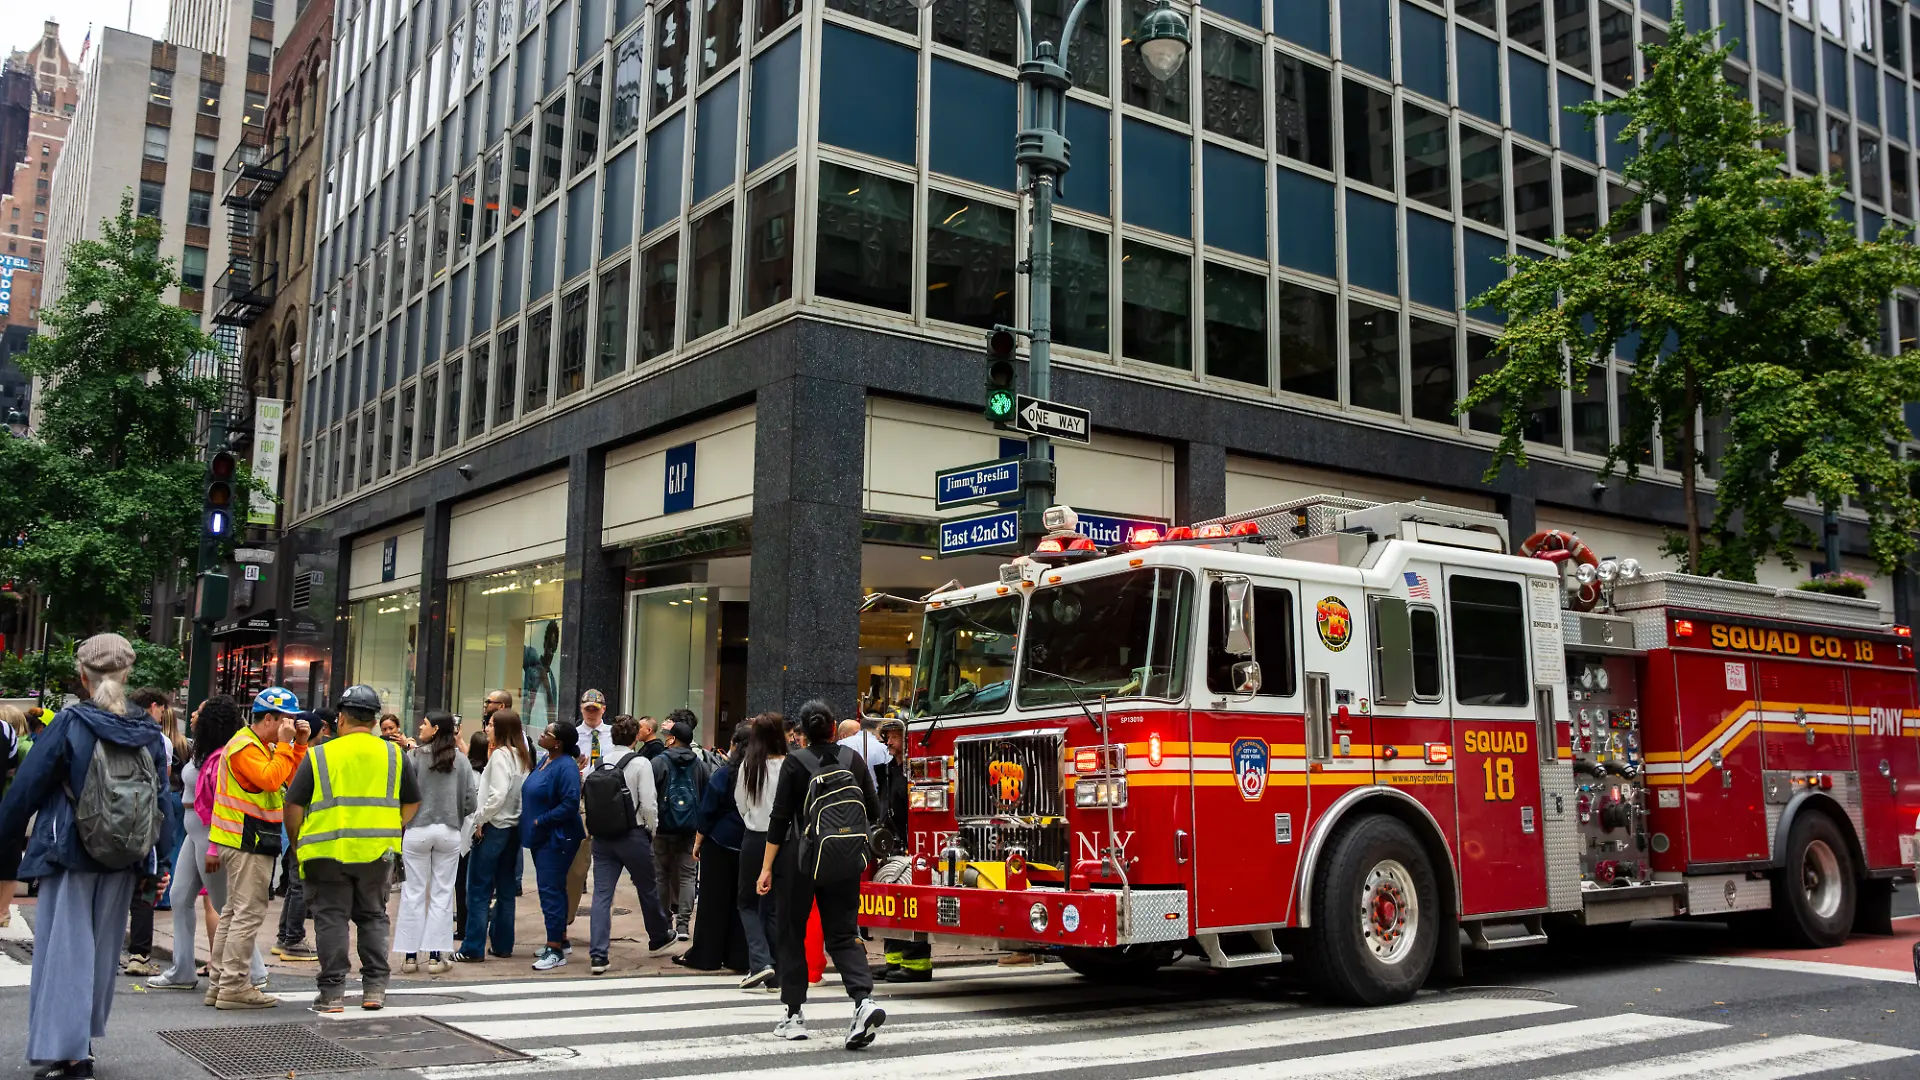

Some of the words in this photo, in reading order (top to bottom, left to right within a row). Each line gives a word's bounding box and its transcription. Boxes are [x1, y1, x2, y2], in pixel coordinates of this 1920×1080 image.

[260, 405, 280, 419] FOOD
[1028, 408, 1049, 424] ONE
[1059, 415, 1081, 431] WAY
[261, 440, 275, 454] FOR
[668, 462, 688, 495] GAP
[946, 476, 975, 492] Jimmy
[977, 467, 1009, 484] Breslin
[972, 486, 987, 496] Way
[944, 530, 968, 547] East
[970, 522, 999, 543] 42nd
[1002, 520, 1015, 538] St
[1077, 521, 1120, 542] Third
[246, 567, 257, 579] EAT
[1531, 580, 1548, 589] SQUAD
[1317, 600, 1349, 622] SQUAD
[1328, 615, 1346, 637] 18
[1533, 621, 1551, 629] ENGINE
[1711, 624, 1799, 655] SQUAD
[1809, 635, 1847, 660] CO.
[1854, 640, 1874, 662] 18
[1726, 665, 1745, 676] FAST
[1729, 677, 1743, 689] PAK
[1870, 707, 1902, 737] FDNY
[1464, 730, 1528, 753] SQUAD
[1391, 773, 1449, 783] www.nyc.gov/fdny
[1482, 757, 1515, 801] 18
[1000, 776, 1020, 802] 18
[903, 897, 917, 918] 18
